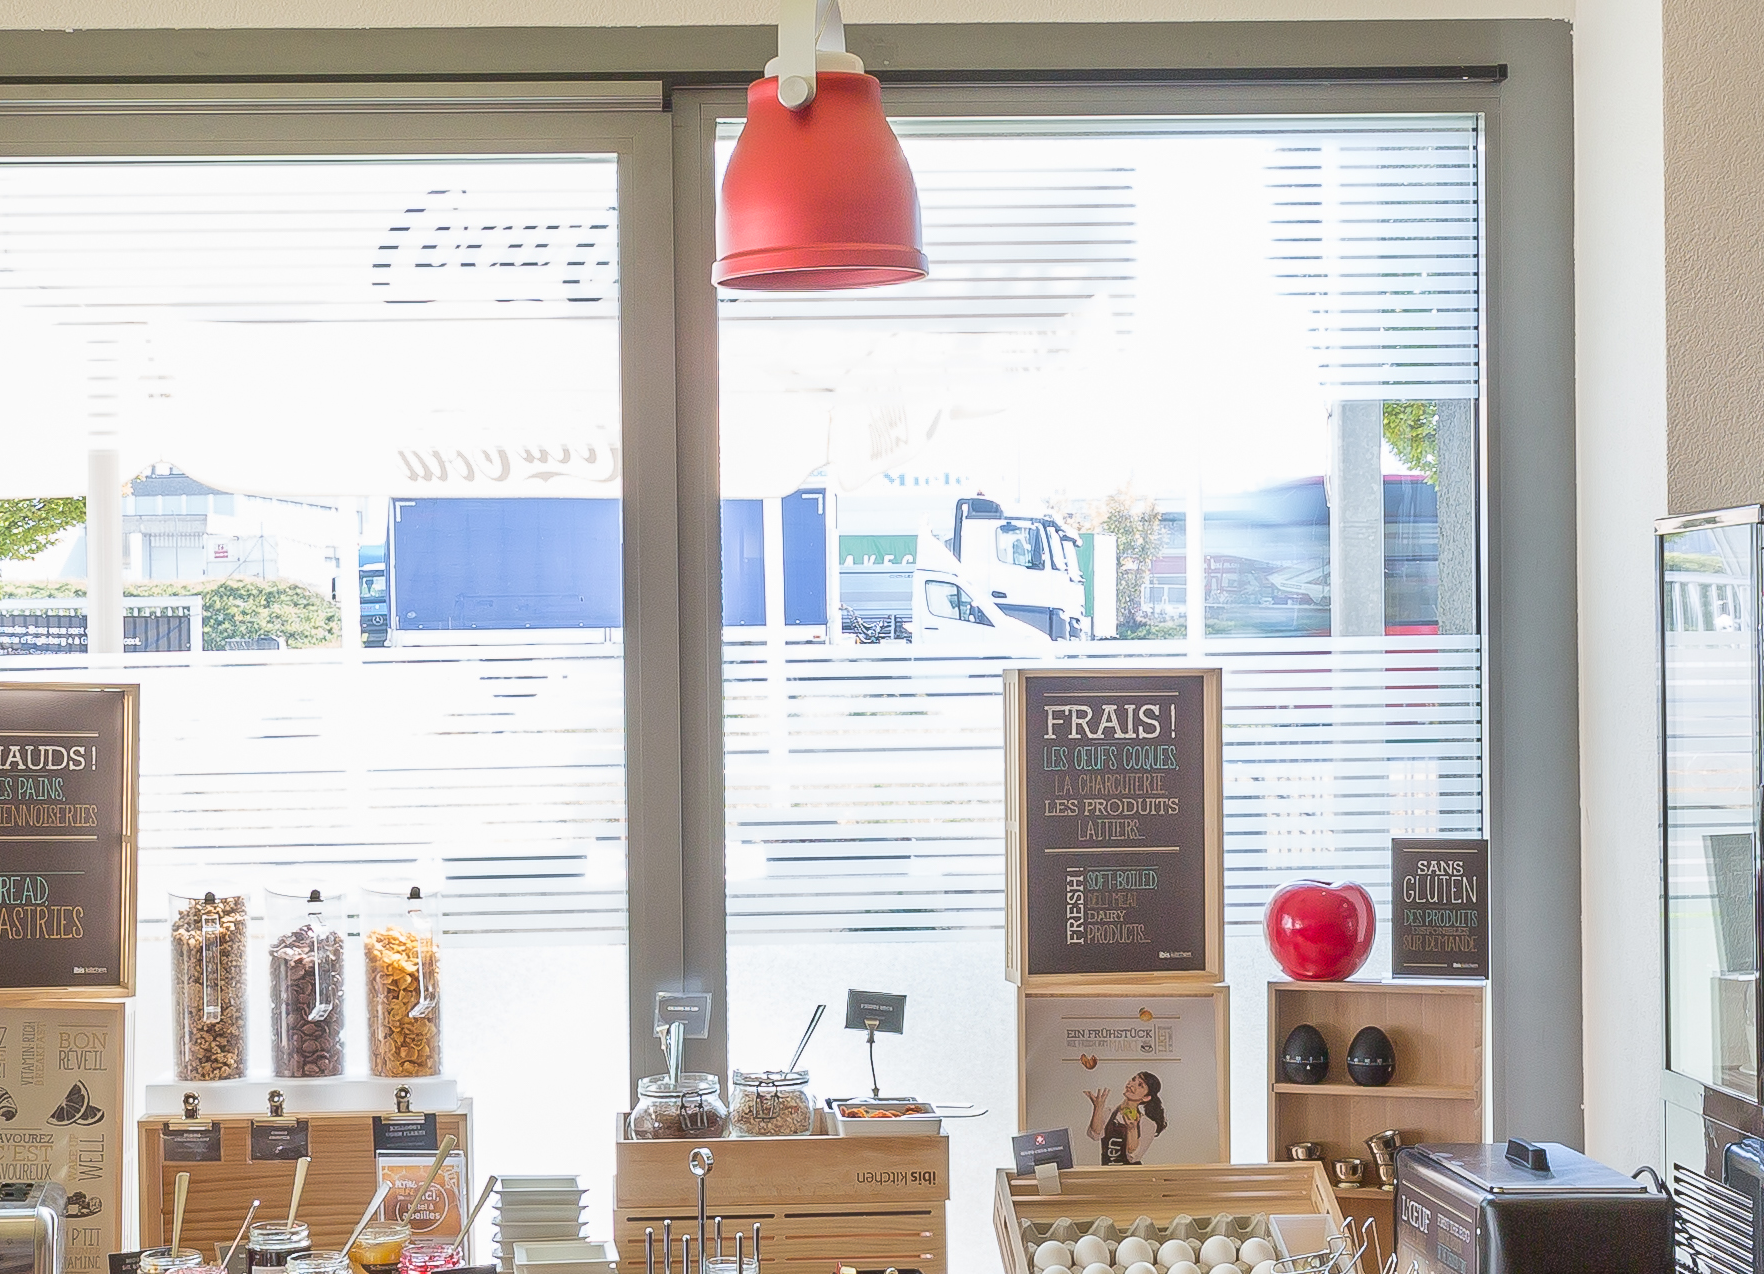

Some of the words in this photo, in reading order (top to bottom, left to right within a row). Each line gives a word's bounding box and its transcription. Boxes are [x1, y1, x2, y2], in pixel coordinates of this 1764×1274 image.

[1043, 746, 1068, 771] LES
[1123, 745, 1180, 771] COQUES,
[1055, 774, 1072, 795] LA
[1044, 799, 1078, 816] LES
[1084, 798, 1179, 816] PRODUITS
[1417, 860, 1464, 875] SANS
[1403, 875, 1477, 904] GLUTEN
[1087, 910, 1127, 922] DAIRY
[1403, 909, 1423, 926] DES
[1425, 909, 1478, 927] PRODUITS
[1403, 934, 1423, 951] SUR
[1425, 935, 1478, 952] DEMANDE
[58, 1032, 108, 1050] BON
[1066, 1029, 1085, 1039] EIN
[1088, 1027, 1153, 1039] FRÜHSTÜCK
[58, 1048, 108, 1071] RÉVEIL
[78, 1133, 105, 1182] WELL
[856, 1171, 907, 1186] kitchen
[910, 1171, 936, 1185] ibis
